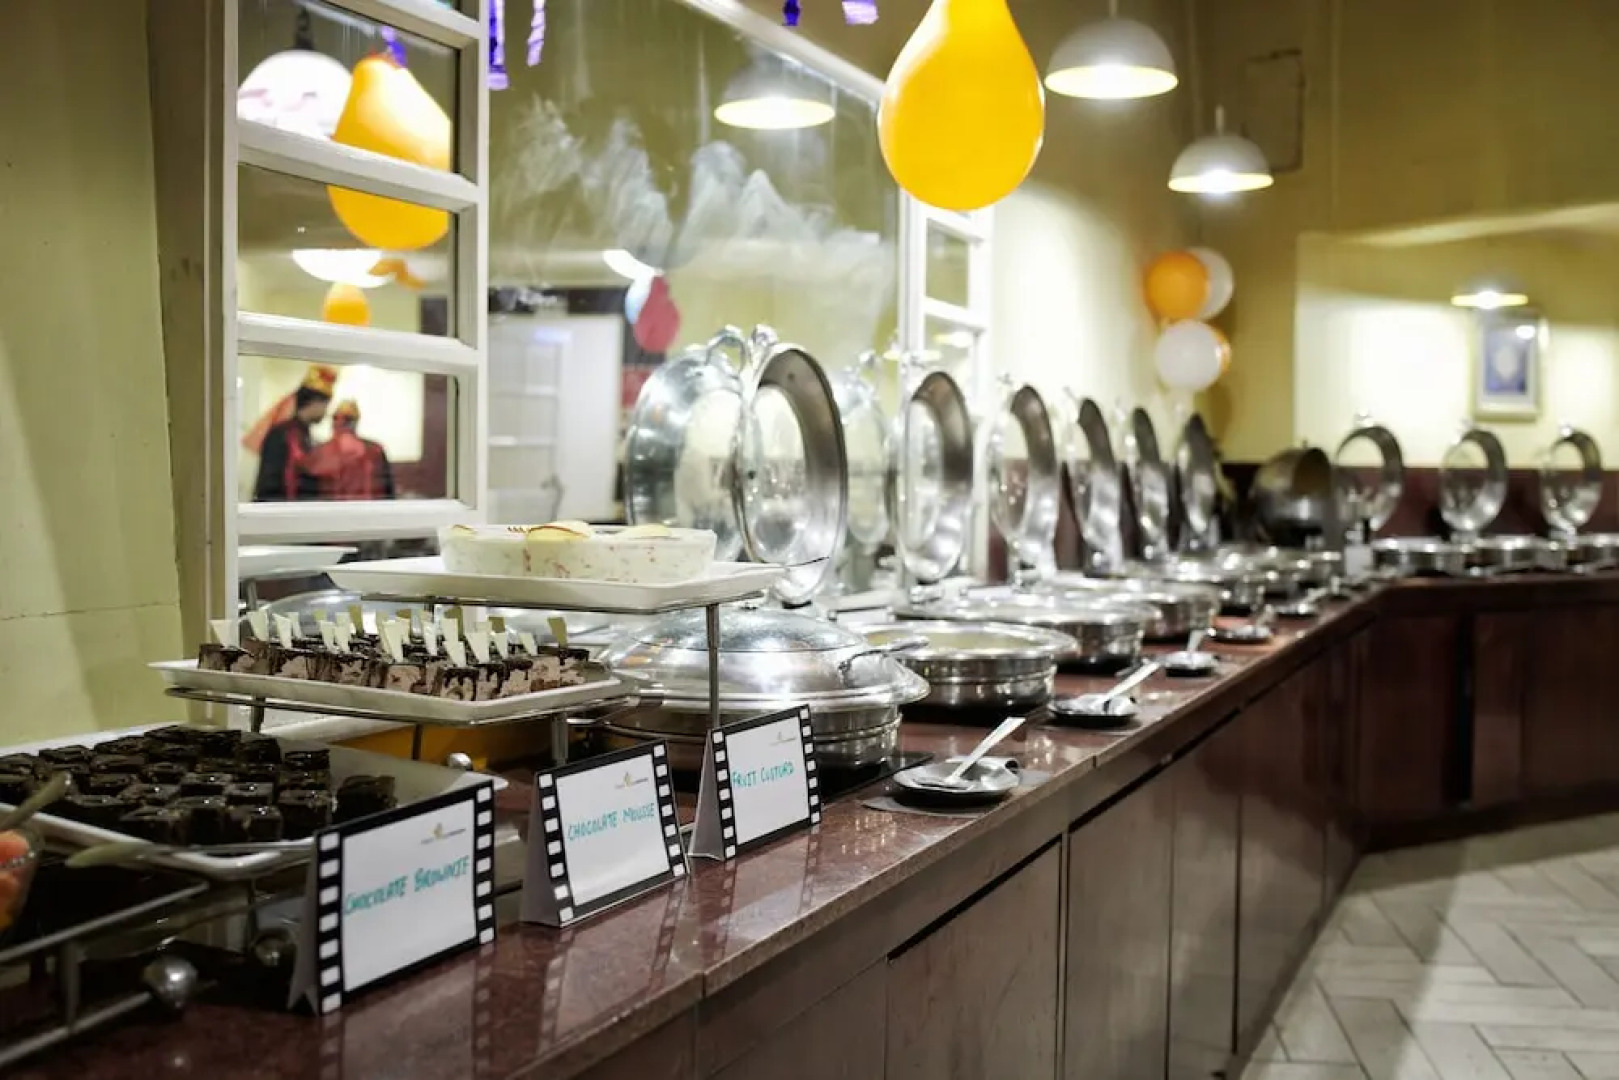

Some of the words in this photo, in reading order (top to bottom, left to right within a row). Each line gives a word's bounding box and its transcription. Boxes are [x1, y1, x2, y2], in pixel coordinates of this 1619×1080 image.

[732, 770, 757, 788] FRUIT
[568, 810, 618, 841] CHOCOLATE
[344, 876, 408, 914] CHOCOLATE
